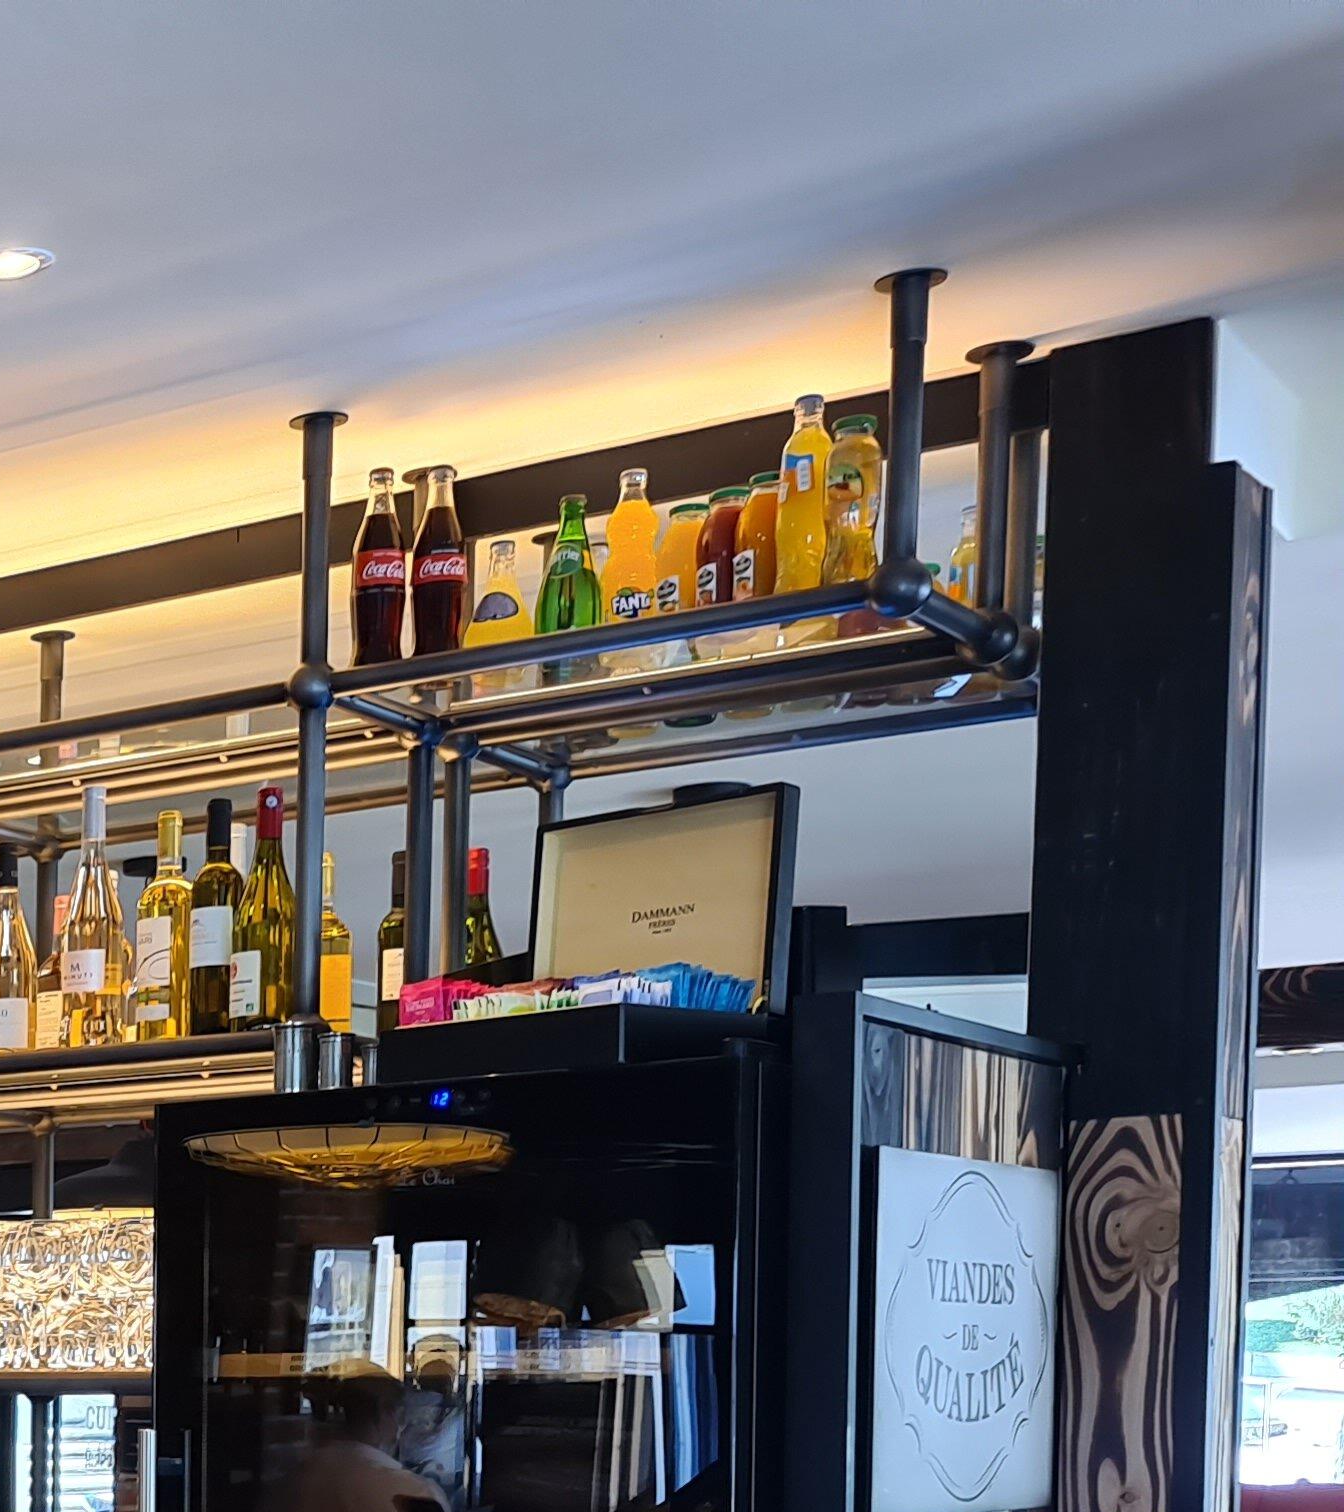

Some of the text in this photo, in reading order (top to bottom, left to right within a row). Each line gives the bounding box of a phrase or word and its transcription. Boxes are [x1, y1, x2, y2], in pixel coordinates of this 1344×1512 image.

[632, 903, 696, 923] DAMMANN
[434, 1091, 449, 1106] 12
[926, 1257, 1015, 1305] VIANDES
[961, 1323, 979, 1351] DE
[914, 1332, 1025, 1423] QUALITÉ
